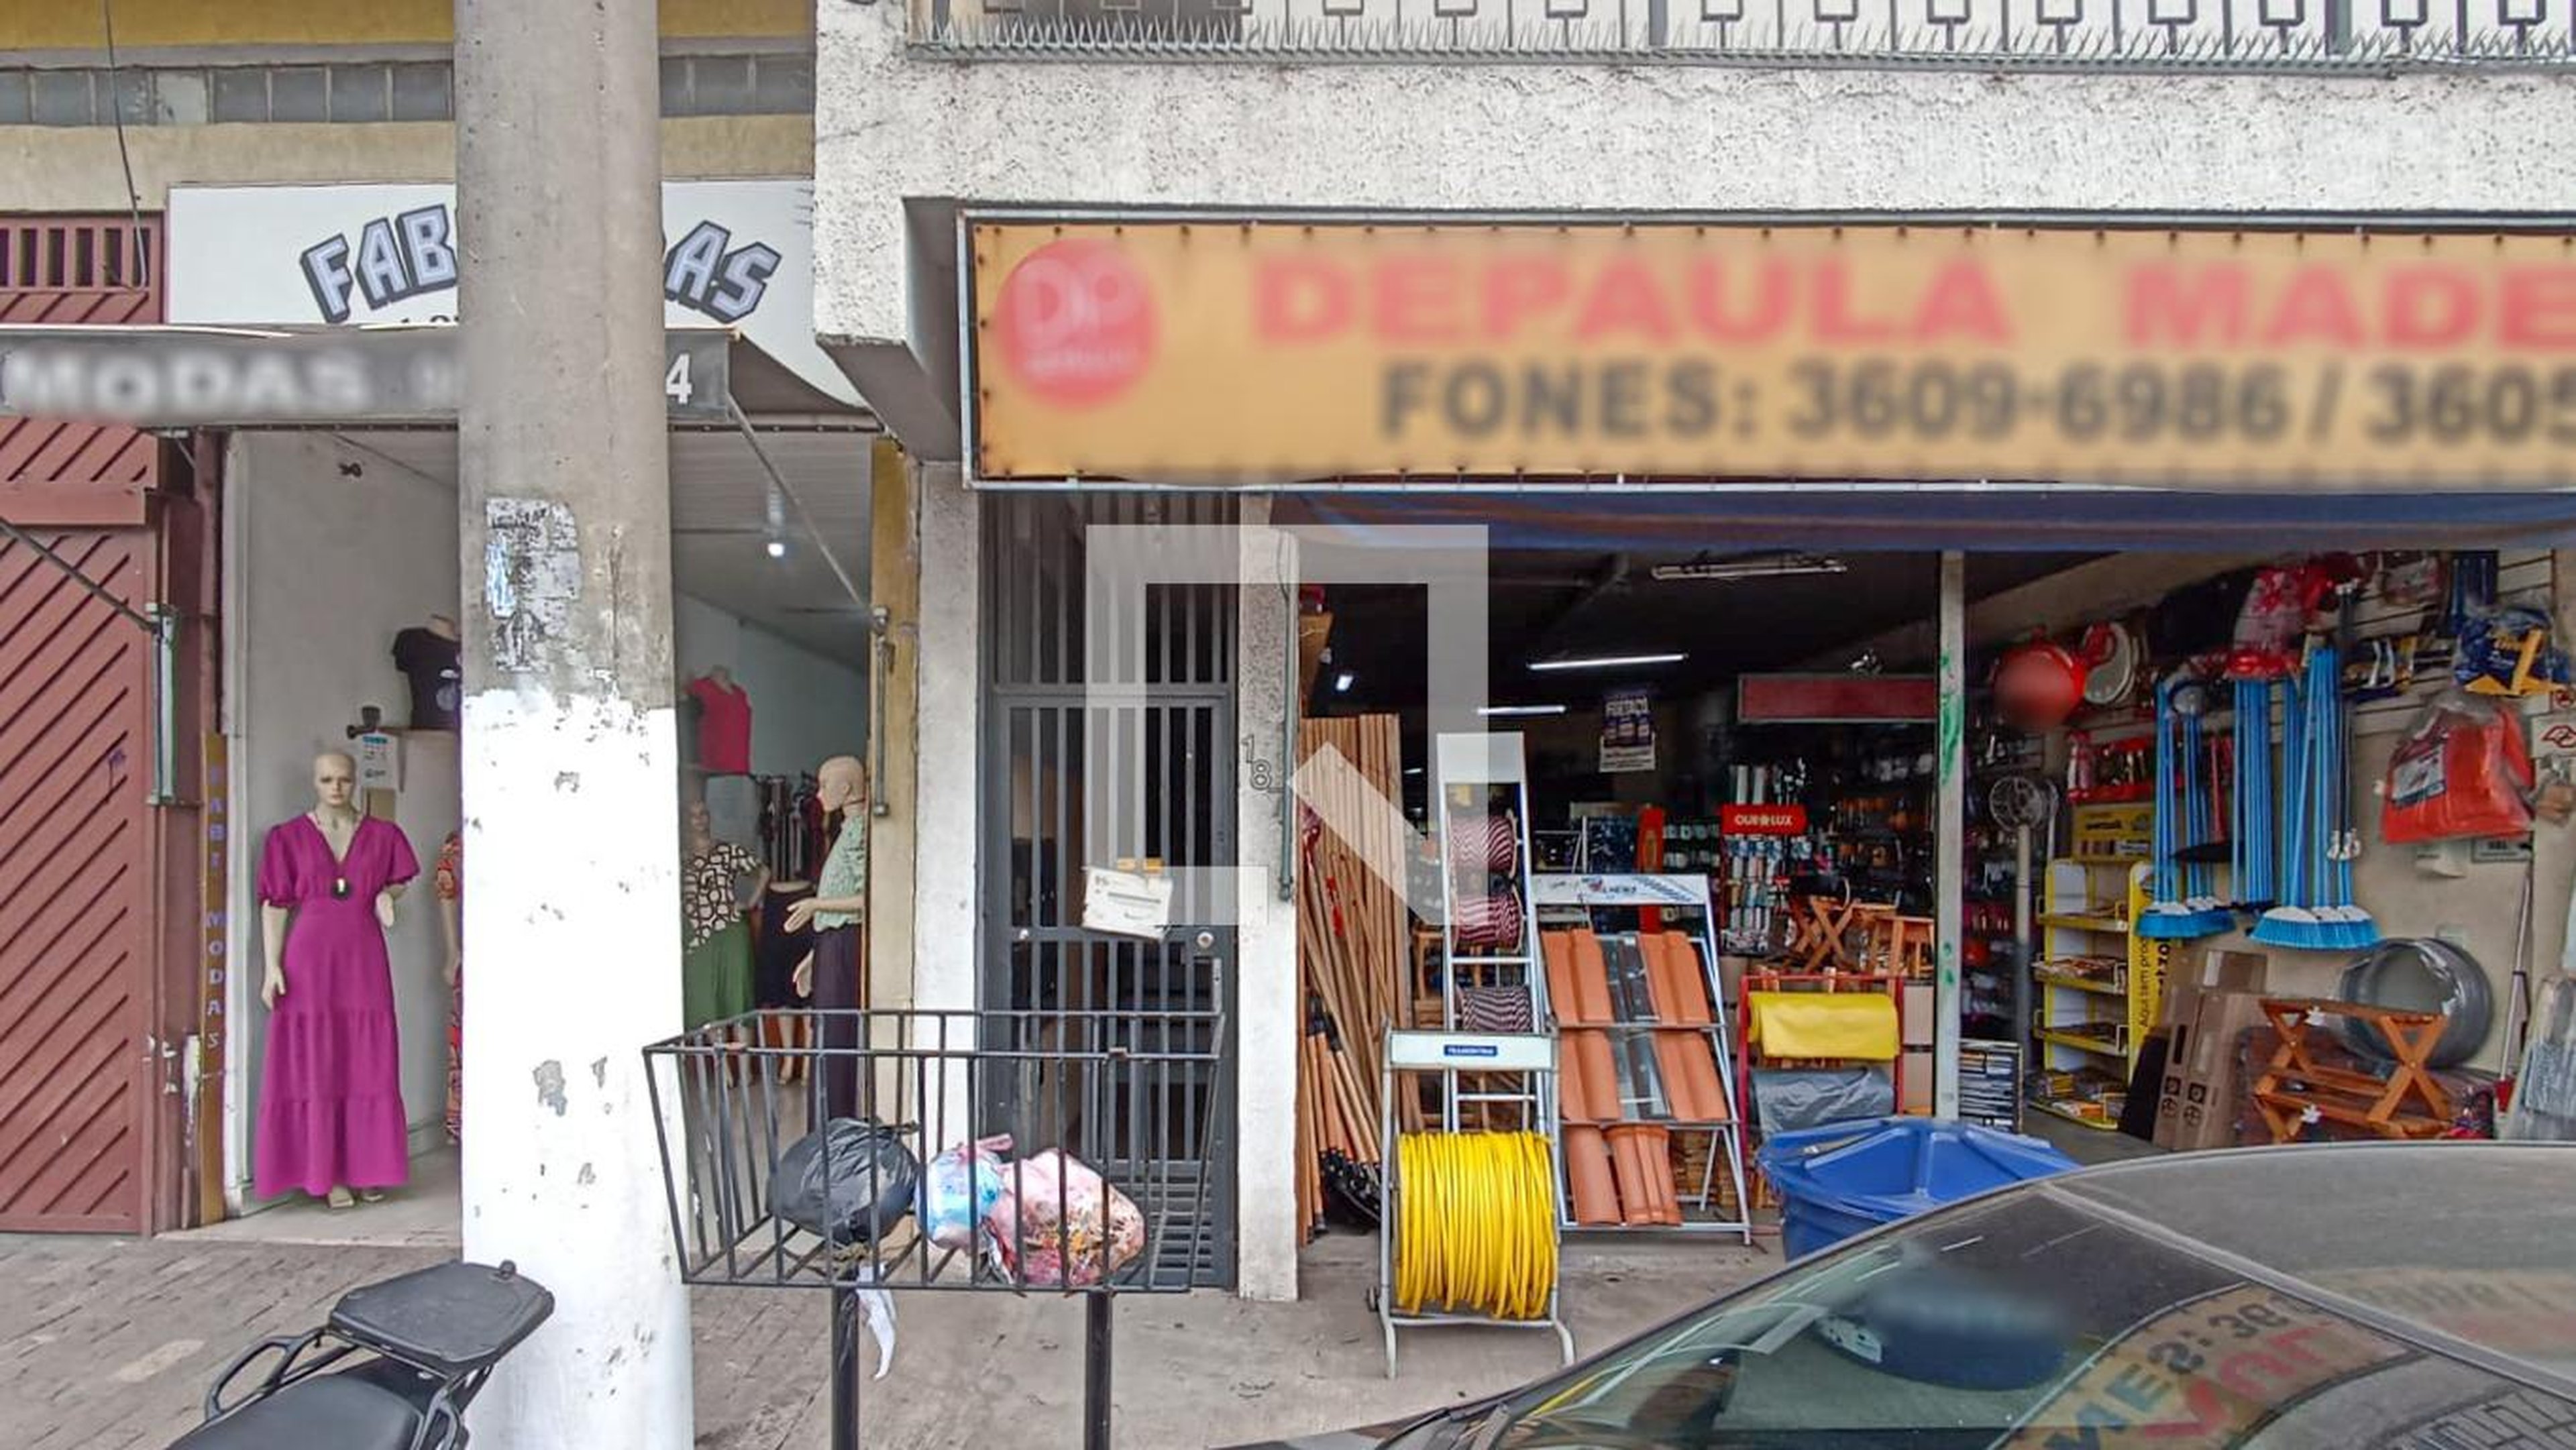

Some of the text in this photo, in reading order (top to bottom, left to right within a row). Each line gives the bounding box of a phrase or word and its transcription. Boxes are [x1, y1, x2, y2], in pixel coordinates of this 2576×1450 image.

[1254, 260, 2014, 345] DEPAULA
[1378, 357, 1762, 440] FONES:
[205, 910, 226, 1050] MODAS
